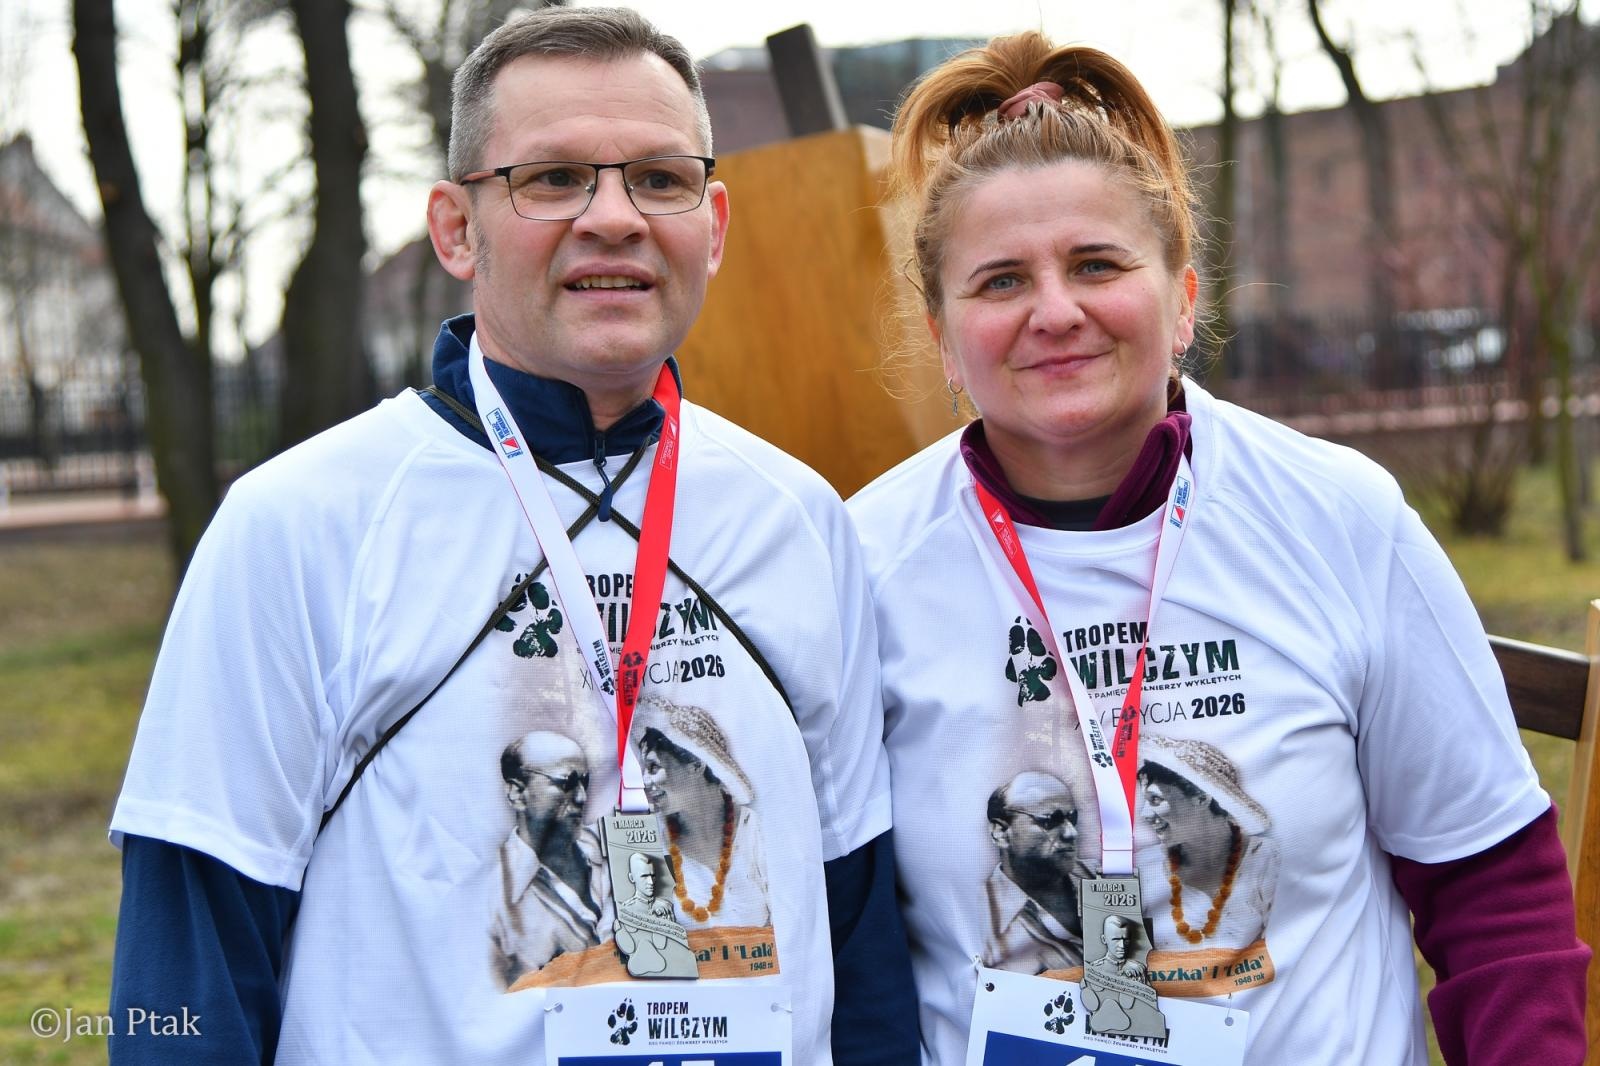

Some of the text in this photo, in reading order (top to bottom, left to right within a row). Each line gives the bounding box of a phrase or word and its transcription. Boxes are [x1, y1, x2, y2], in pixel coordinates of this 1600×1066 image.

[585, 573, 633, 598] ROPE
[1062, 621, 1150, 653] TROPEM
[680, 654, 726, 683] 2026
[1070, 639, 1241, 691] WILCZYM
[1185, 674, 1242, 688] WYKLĘTYCH
[1112, 698, 1187, 728] EYCJA
[1191, 692, 1246, 719] 2026
[619, 820, 644, 829] MARCA
[626, 830, 656, 844] 2026
[1096, 883, 1124, 893] MARCA
[1104, 893, 1136, 906] 2026
[647, 1001, 689, 1015] TROPEM
[647, 1016, 728, 1039] WILCZYM
